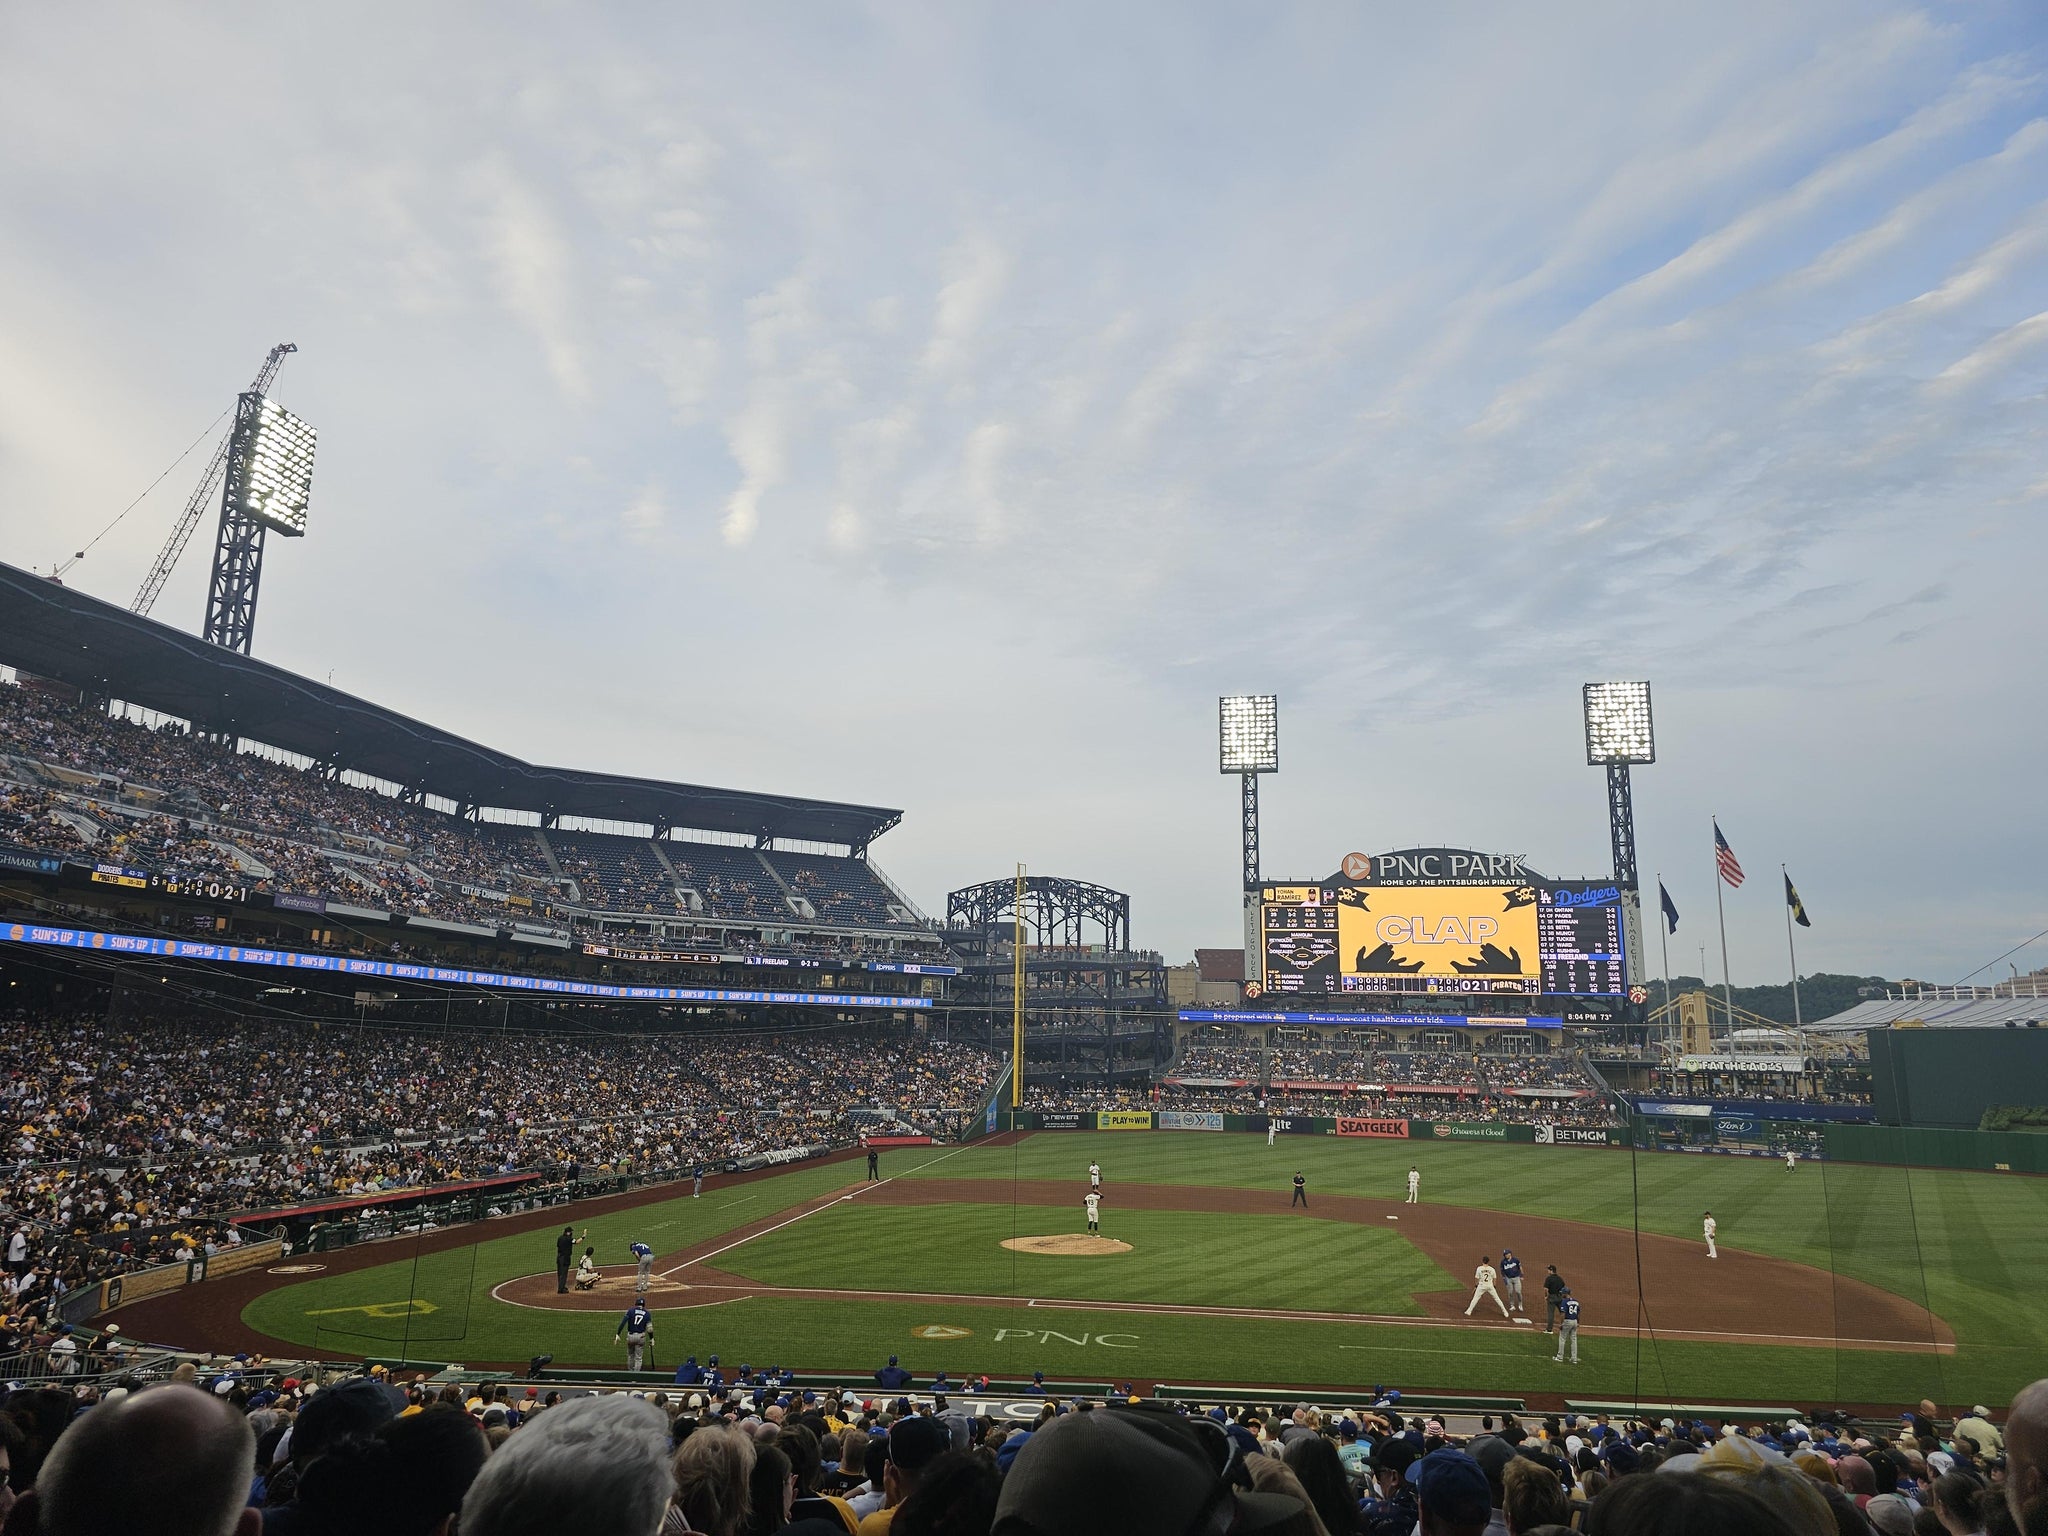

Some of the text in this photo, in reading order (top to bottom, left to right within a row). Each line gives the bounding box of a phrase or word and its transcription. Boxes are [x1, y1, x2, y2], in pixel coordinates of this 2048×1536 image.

[98, 864, 122, 875] DODGERS
[1377, 854, 1527, 877] PNC PARK
[98, 873, 119, 883] PIRATES
[152, 876, 159, 886] 5
[186, 878, 191, 886] 7
[197, 880, 203, 888] 0
[209, 883, 219, 898] 0
[224, 885, 233, 900] 2
[240, 887, 246, 902] 1
[184, 887, 189, 895] 2
[1540, 889, 1551, 903] LA
[1555, 886, 1620, 907] Dodgers
[281, 897, 319, 909] xfinity mobile
[32, 929, 59, 941] SUN'S
[60, 932, 73, 943] UP
[1376, 916, 1498, 945] CLAP
[111, 937, 148, 950] SUN'S UP
[181, 944, 215, 956] SUN'S UP
[244, 951, 274, 962] SUN'S UP
[762, 958, 789, 966] FREELAND
[1492, 981, 1522, 992] PIRATES
[1427, 1016, 1446, 1024] kids.
[1207, 1114, 1220, 1126] 125
[1273, 1118, 1291, 1130] Lite
[1718, 1121, 1745, 1130] Ford
[1340, 1120, 1404, 1135] SEATGEEK
[1452, 1127, 1477, 1136] Growers
[1485, 1127, 1506, 1136] Good
[1556, 1130, 1607, 1141] BETMGM
[1484, 1274, 1489, 1282] 2
[634, 1315, 643, 1325] 17
[992, 1328, 1140, 1348] PNC
